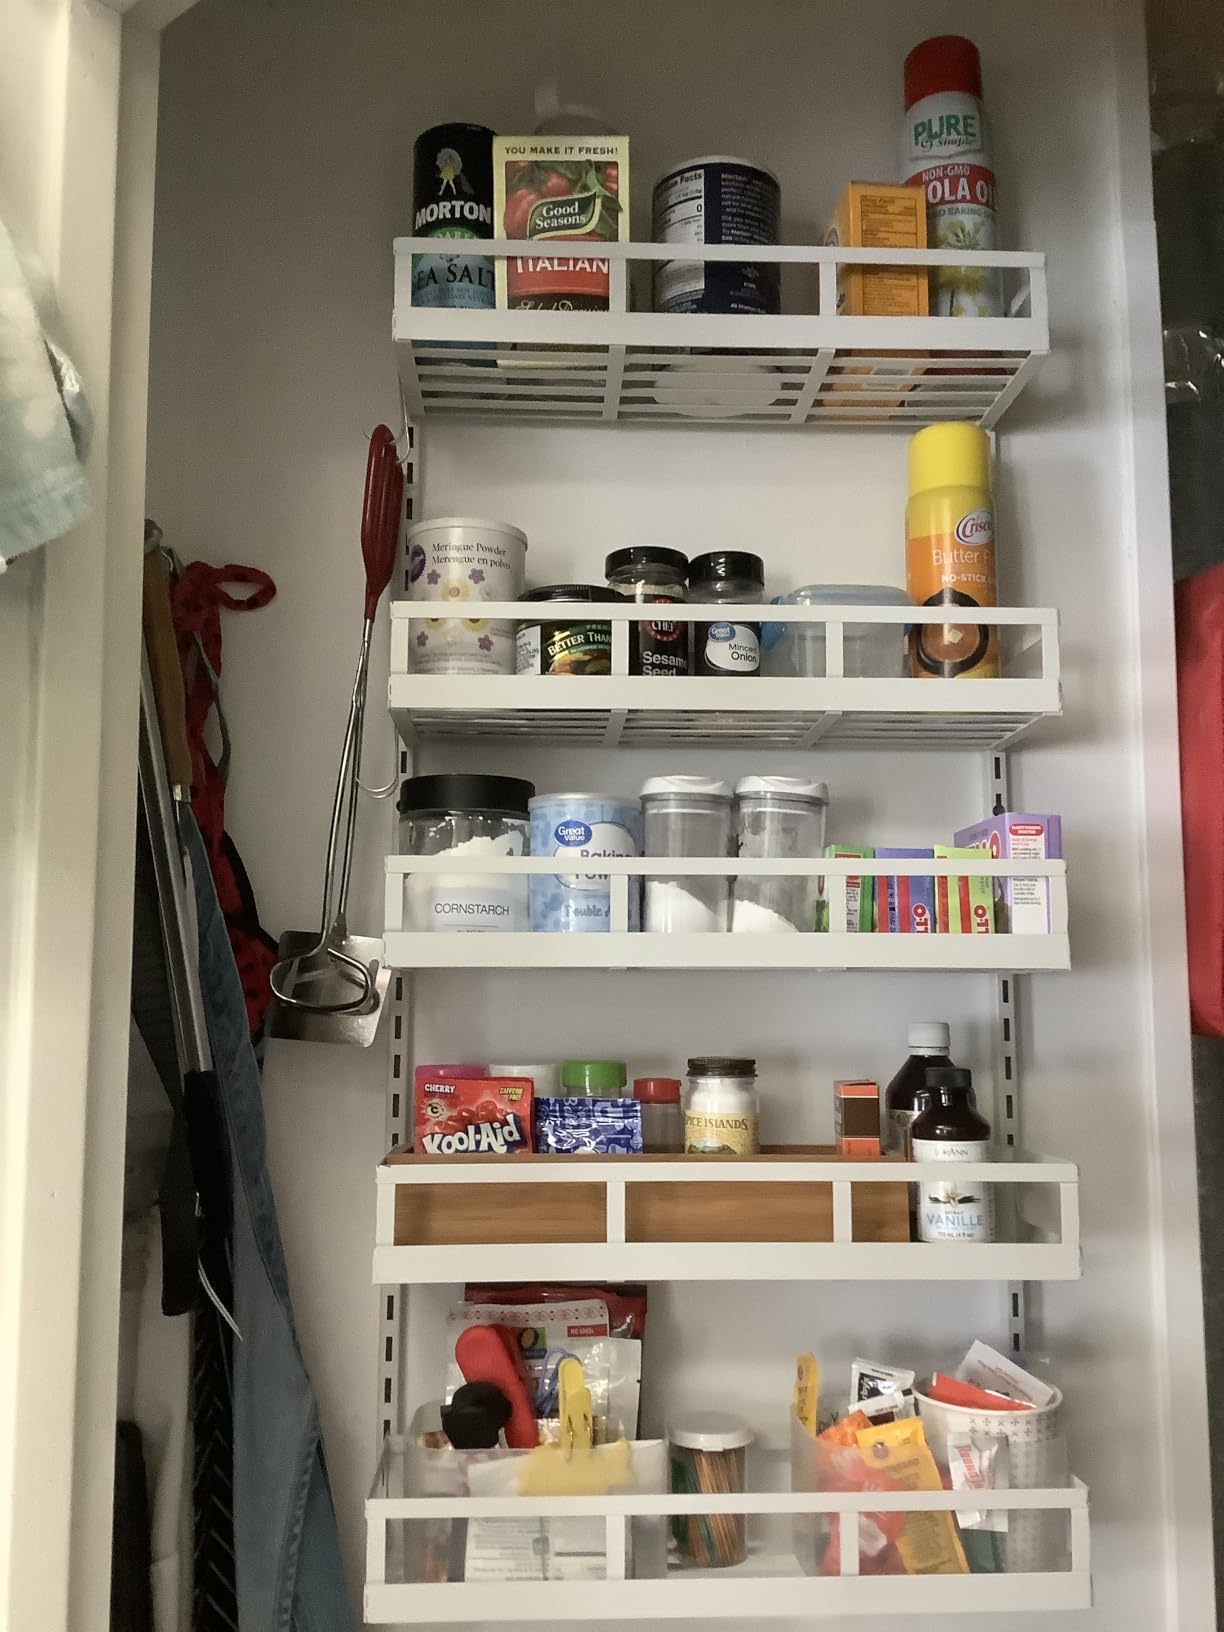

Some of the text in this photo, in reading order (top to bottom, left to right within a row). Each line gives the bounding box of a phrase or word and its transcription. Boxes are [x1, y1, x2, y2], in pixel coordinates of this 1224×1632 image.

[913, 114, 976, 146] PURE
[504, 146, 618, 155] YOU MAKE IT FRESH!
[922, 165, 971, 182] NON-GMO
[926, 177, 971, 204] OLA
[415, 200, 492, 230] MORTON
[542, 201, 579, 216] Good
[696, 204, 703, 213] 0
[535, 211, 587, 229] Seasons
[517, 256, 609, 274] ITALIAN
[413, 266, 439, 290] EA
[961, 517, 994, 538] Crisco
[432, 543, 507, 556] Meringue Powder
[932, 548, 979, 566] Butter
[432, 555, 512, 570] Merengue en polvo
[547, 634, 585, 656] BETTER
[728, 642, 757, 654] Minced
[642, 651, 688, 668] Sesame
[731, 651, 757, 663] Onion
[642, 664, 677, 677] Seed
[558, 826, 585, 836] Great
[564, 833, 585, 842] Value
[434, 903, 510, 916] CORNSTARCH
[424, 1084, 455, 1094] CHERRY
[704, 1118, 748, 1130] ISLANDS
[422, 1113, 521, 1154] Kool-Aid
[927, 1212, 984, 1226] VANILLE
